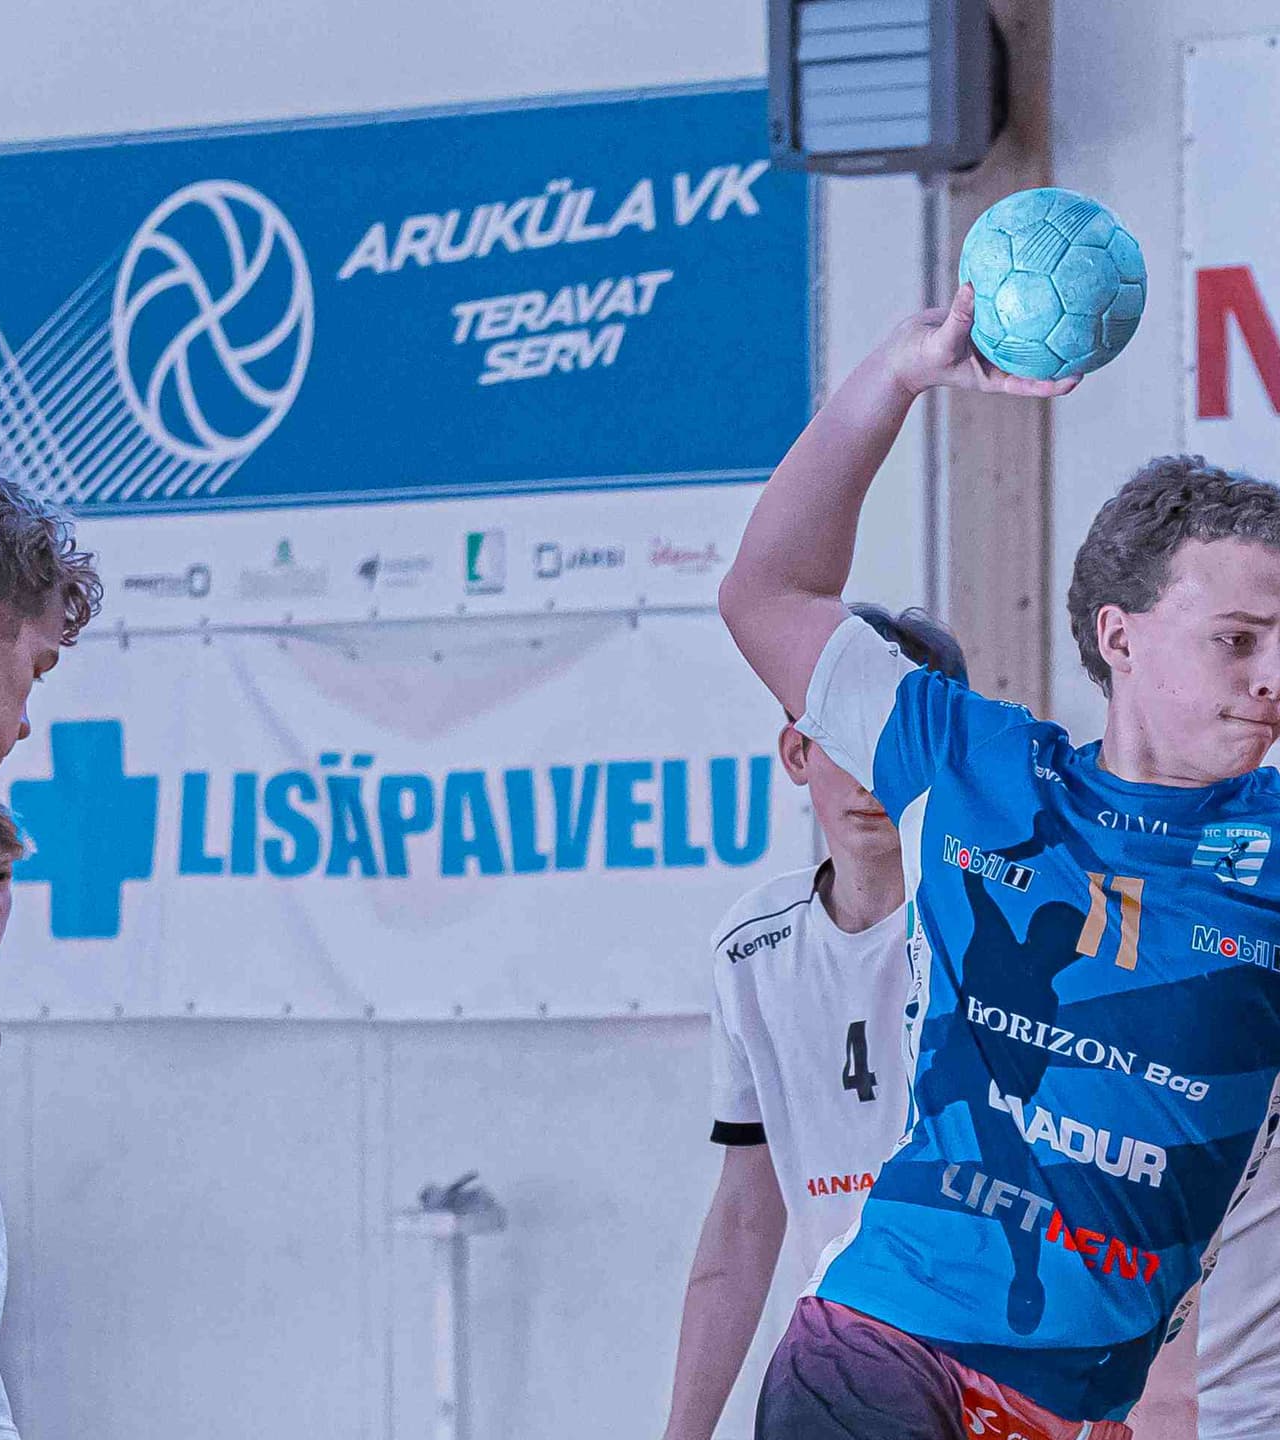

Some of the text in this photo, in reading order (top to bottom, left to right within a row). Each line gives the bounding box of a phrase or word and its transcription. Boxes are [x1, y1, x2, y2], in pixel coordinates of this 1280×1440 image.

[337, 160, 770, 280] ARUKÜLA VK
[453, 271, 673, 344] TERAVAT
[479, 324, 626, 386] SERVI
[178, 752, 772, 879] LISÄPALVELU
[1204, 829, 1221, 838] HC
[943, 834, 1005, 880] Mobil
[726, 924, 793, 965] Kempa
[1076, 872, 1144, 971] 11
[1192, 925, 1270, 978] Mobil
[842, 1020, 879, 1102] 4
[966, 996, 1137, 1075] HORIZON
[1144, 1061, 1211, 1103] Bag
